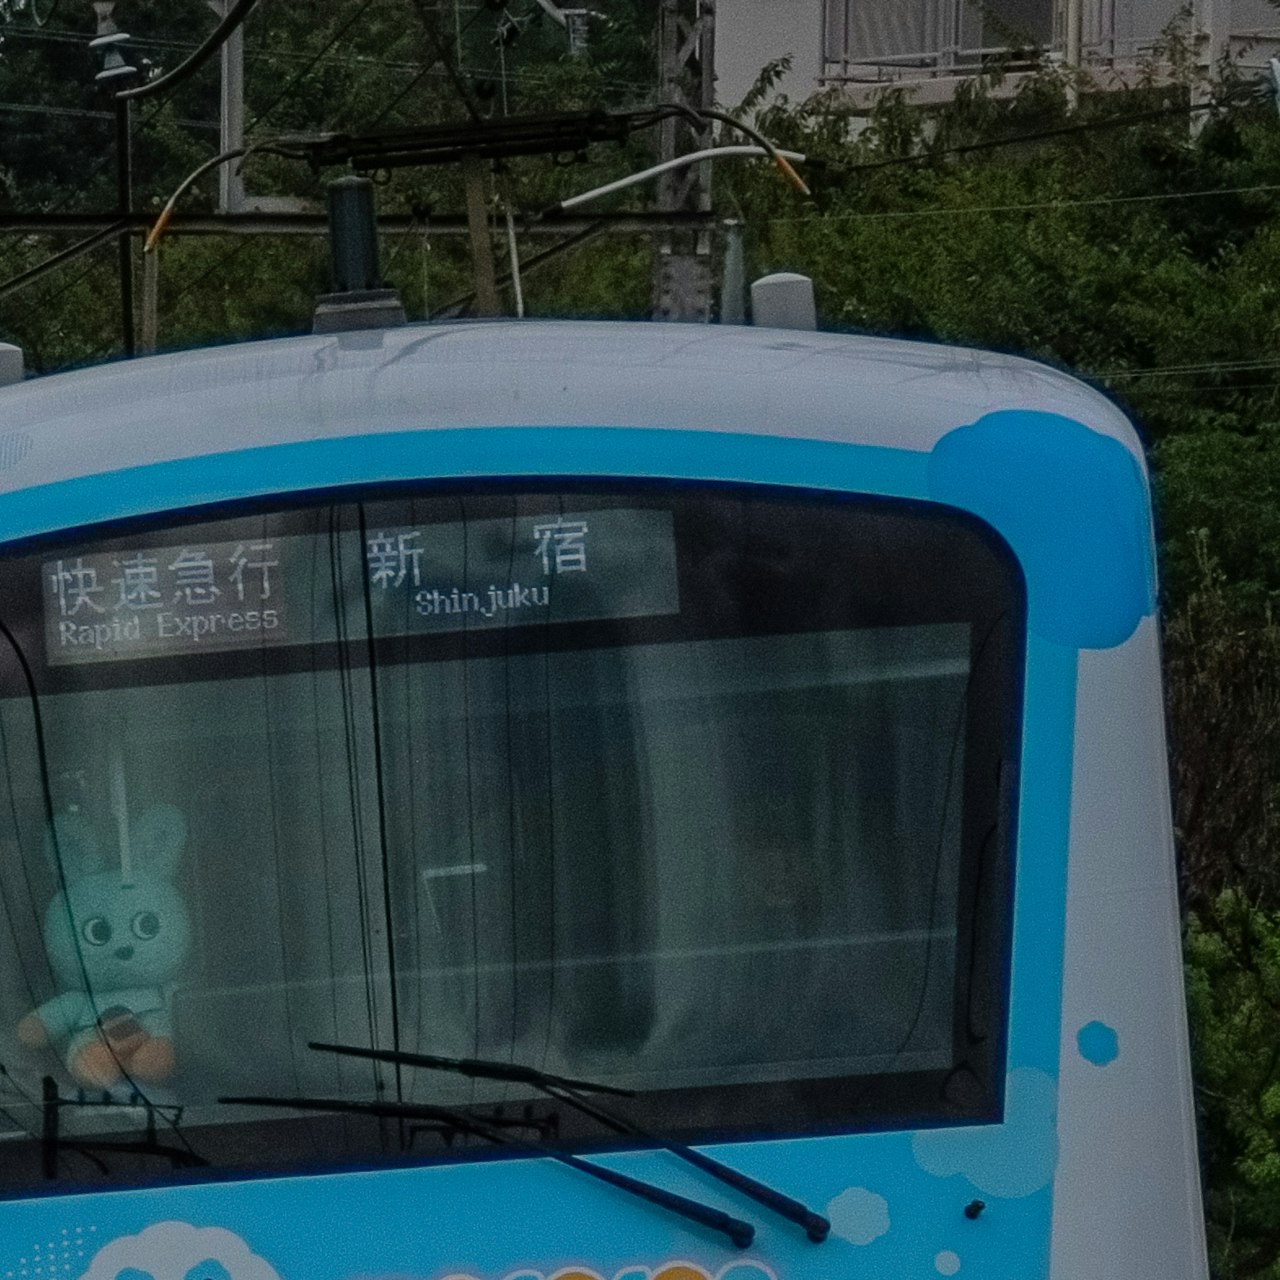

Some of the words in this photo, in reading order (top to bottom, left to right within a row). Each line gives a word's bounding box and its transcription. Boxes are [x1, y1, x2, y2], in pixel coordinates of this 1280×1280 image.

[52, 543, 279, 616] 快速急行
[415, 583, 550, 617] Shinjuku
[59, 615, 141, 650] Rapid
[157, 609, 279, 642] Express
